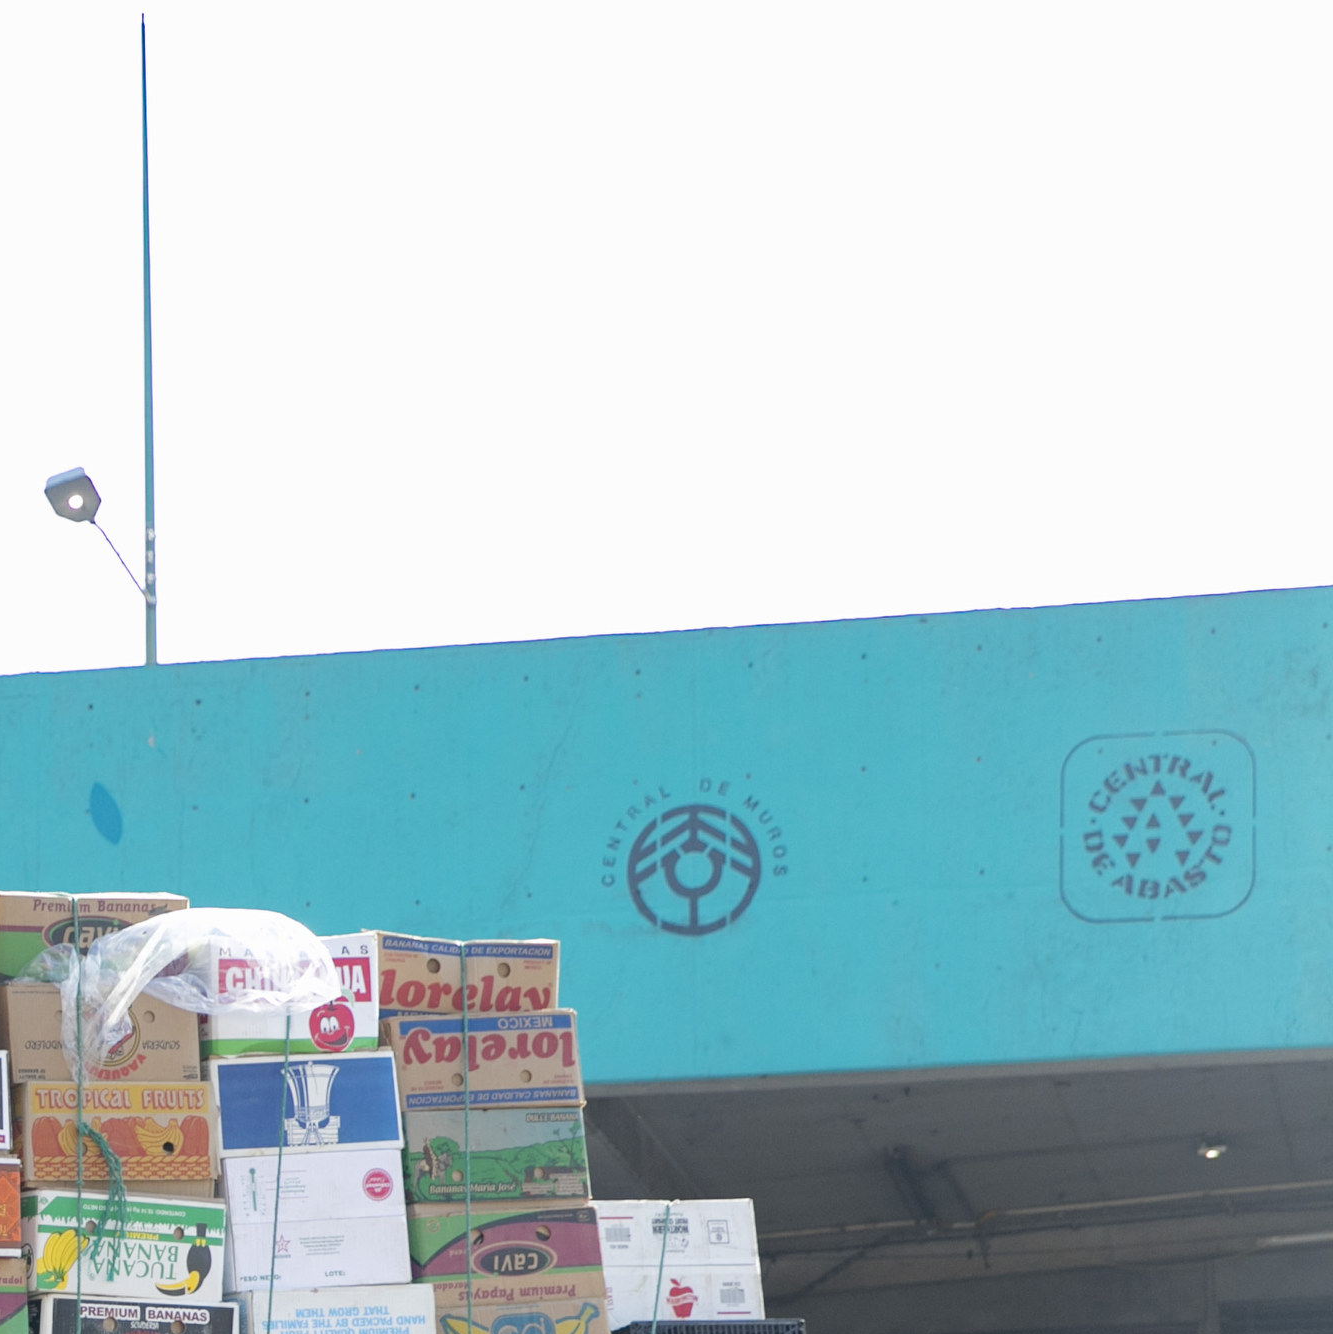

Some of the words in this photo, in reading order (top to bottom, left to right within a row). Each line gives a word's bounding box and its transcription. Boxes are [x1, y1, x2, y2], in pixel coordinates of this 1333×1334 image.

[601, 785, 672, 887] CENTRAL
[699, 777, 730, 797] DE
[742, 795, 788, 877] MUROS
[33, 899, 91, 913] Premim
[96, 899, 156, 914] Bananas
[384, 938, 429, 952] BANANAS
[431, 943, 469, 956] CALIDD
[471, 945, 483, 955] DE
[498, 1015, 553, 1029] MEXICO
[403, 1028, 576, 1072] lorelay
[141, 1089, 205, 1109] FRUITS
[477, 1092, 490, 1101] DE
[496, 1090, 532, 1101] CALIDAD
[92, 1259, 178, 1281] TUCANA
[493, 1252, 538, 1277] cavi
[324, 1270, 346, 1278] LOTE:
[520, 1285, 576, 1299] Premium
[80, 1305, 139, 1318] PREMIUM
[147, 1309, 208, 1322] BANANAS
[295, 1308, 324, 1319] THEM
[330, 1306, 360, 1317] GROW
[363, 1305, 390, 1316] THAT
[261, 1319, 310, 1330] FAMILIES
[311, 1318, 332, 1329] THE
[334, 1318, 349, 1327] BY
[352, 1316, 393, 1327] PACKED
[396, 1315, 426, 1326] HAND
